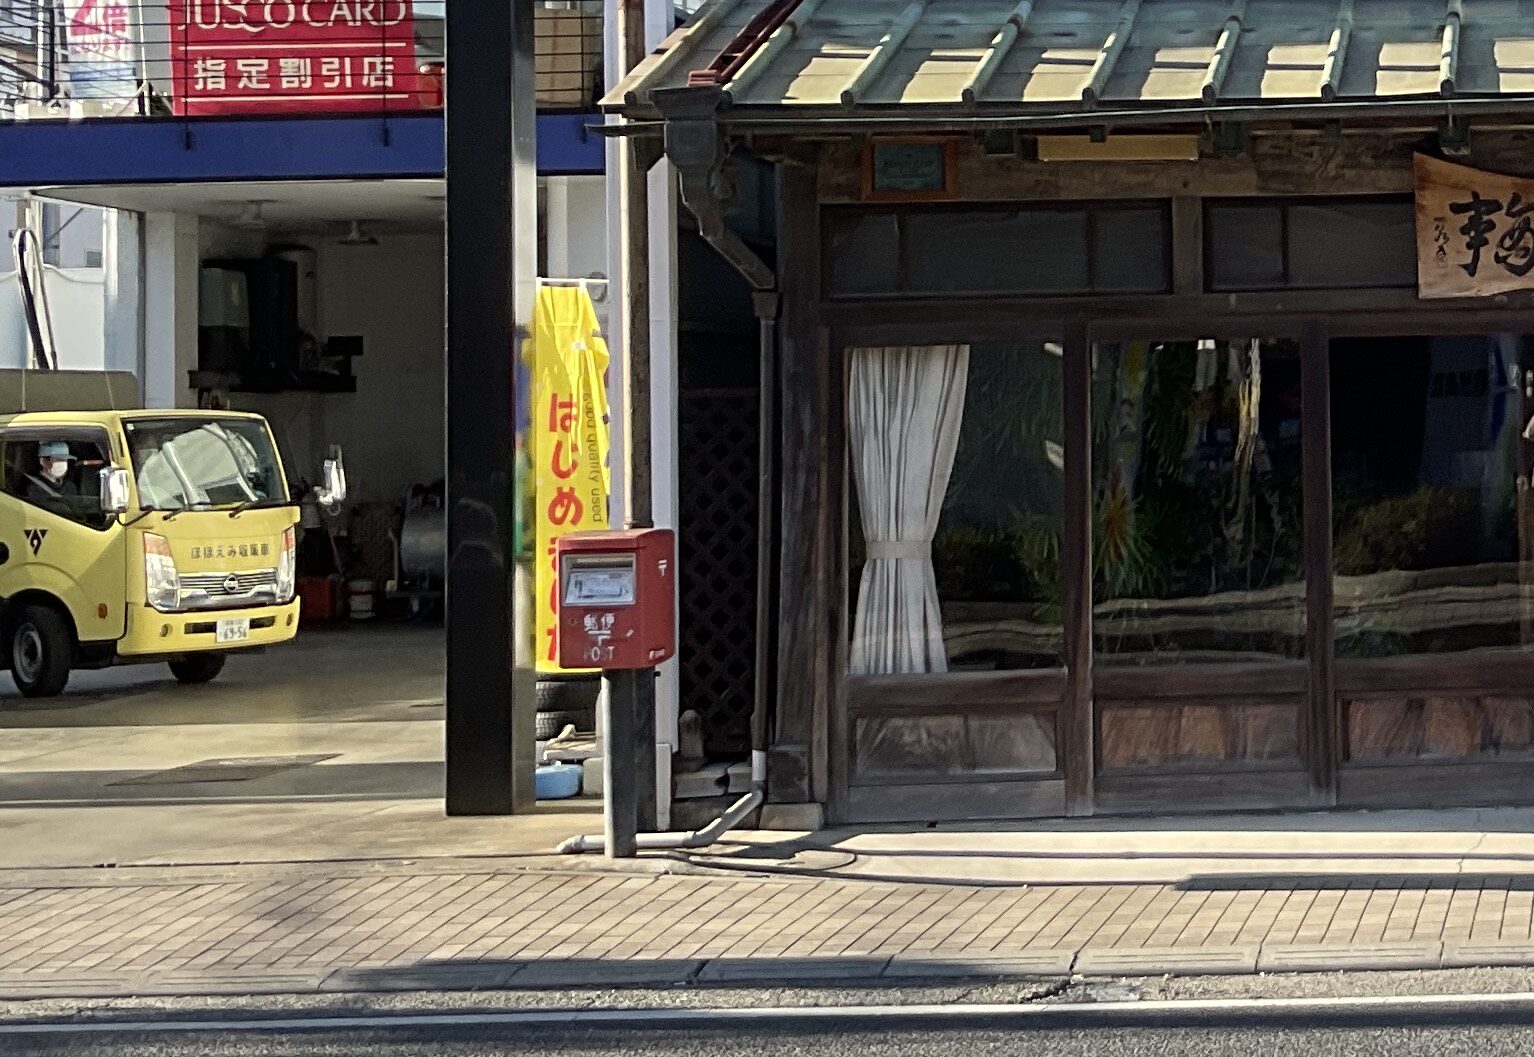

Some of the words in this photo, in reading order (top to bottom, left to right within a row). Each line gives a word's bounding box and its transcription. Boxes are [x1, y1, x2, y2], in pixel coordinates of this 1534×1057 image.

[193, 55, 395, 91] 指定割引店
[591, 488, 604, 524] used
